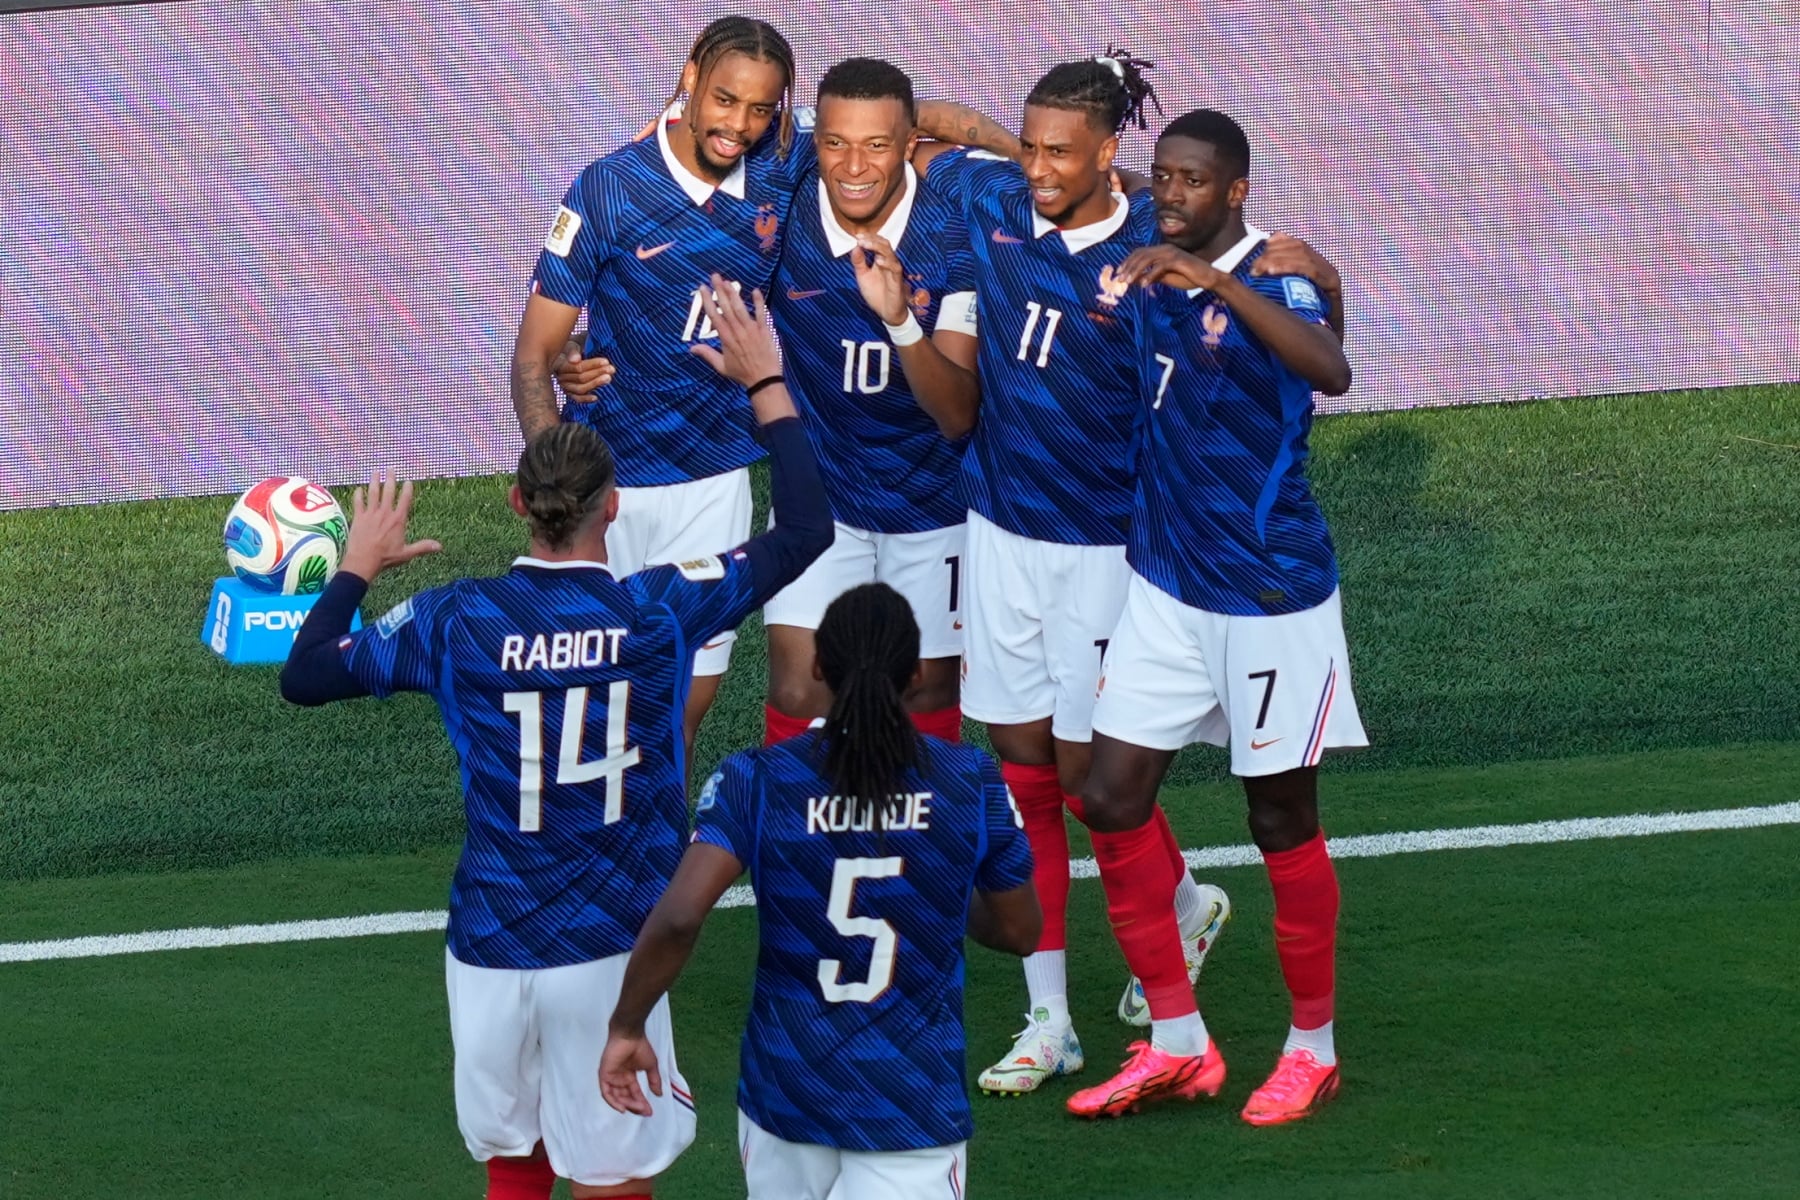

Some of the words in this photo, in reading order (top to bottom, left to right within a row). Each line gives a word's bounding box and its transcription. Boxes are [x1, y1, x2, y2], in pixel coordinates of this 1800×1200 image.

[1017, 301, 1062, 368] 11
[841, 339, 890, 394] 10
[1153, 353, 1175, 410] 7
[501, 628, 628, 672] RABIOT
[1248, 668, 1277, 729] 7
[503, 680, 642, 832] 14
[817, 855, 904, 1003] 5
